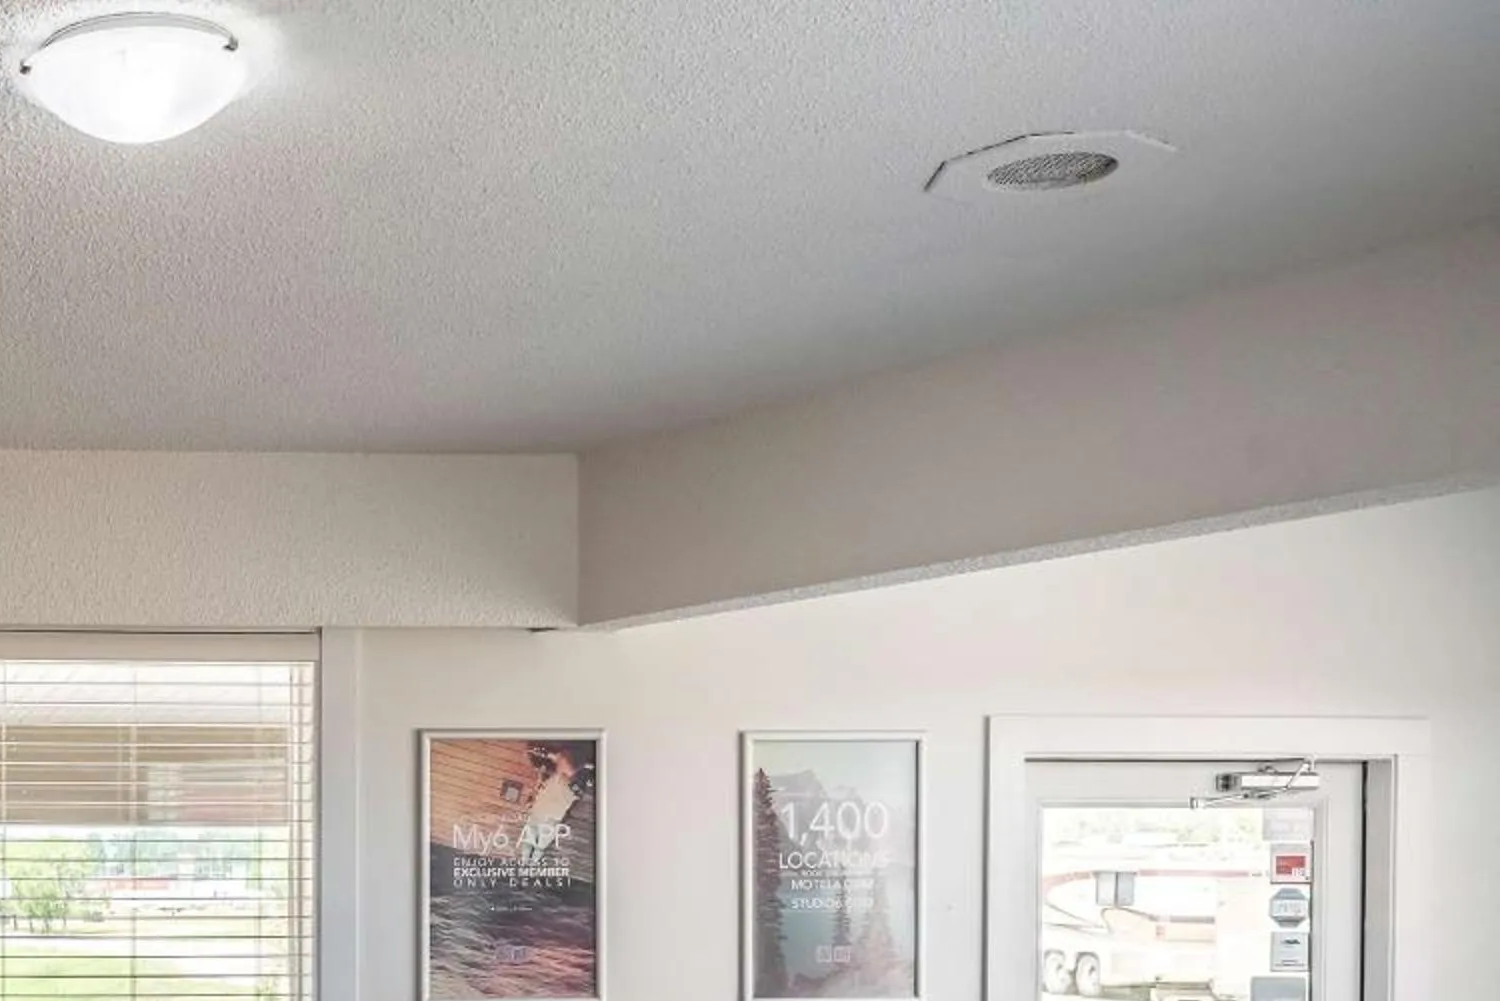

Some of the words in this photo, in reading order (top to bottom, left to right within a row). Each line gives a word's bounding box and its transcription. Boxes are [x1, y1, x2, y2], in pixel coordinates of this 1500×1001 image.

[781, 801, 890, 846] 1,400
[453, 824, 509, 855] My6
[516, 824, 572, 849] APP
[453, 857, 494, 867] ENJOY
[553, 857, 571, 867] TO
[779, 850, 891, 870] LOCATIONS
[453, 867, 516, 877] EXCLUSIVE
[518, 867, 570, 877] MEMBER
[453, 878, 497, 888] ONLY
[509, 878, 572, 888] DEALS!
